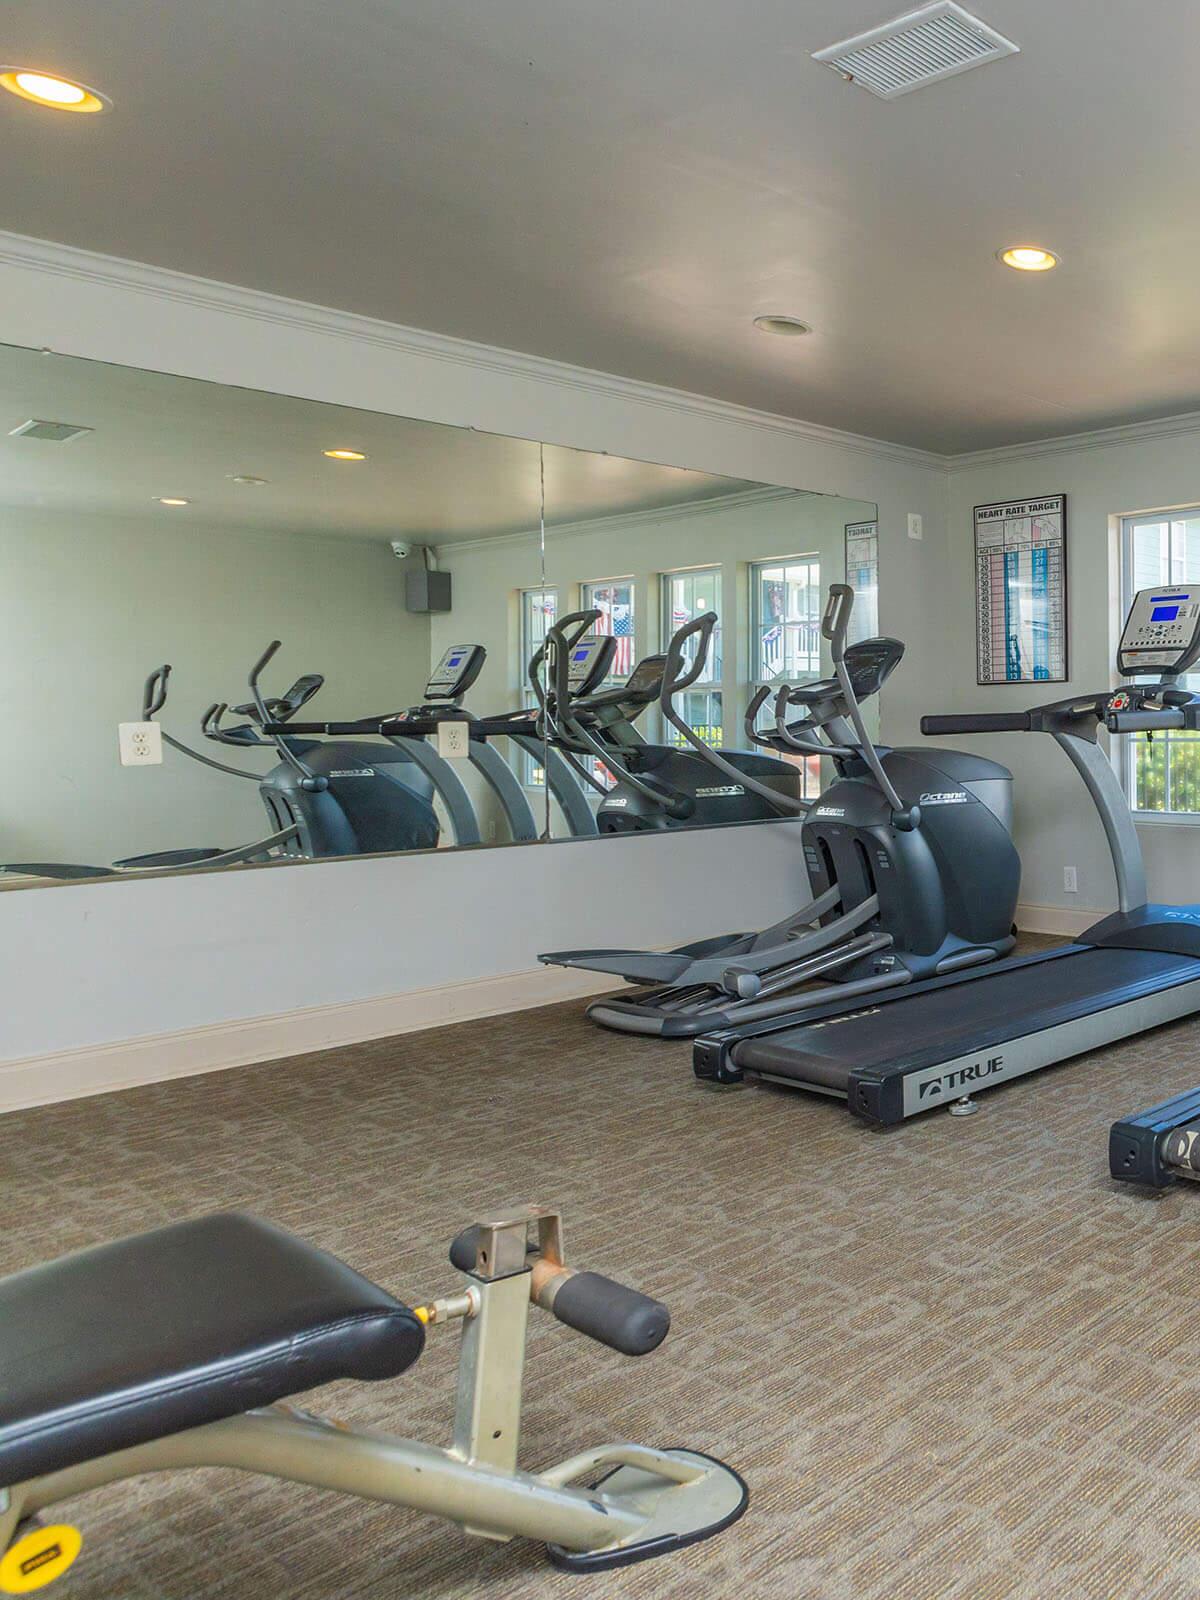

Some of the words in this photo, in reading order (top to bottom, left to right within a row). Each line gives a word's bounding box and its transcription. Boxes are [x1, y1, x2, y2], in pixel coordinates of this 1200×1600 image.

[978, 509, 1003, 519] HEART
[1005, 506, 1026, 515] RATE
[1028, 501, 1060, 513] TARGET
[919, 792, 966, 801] Octane
[944, 1056, 1004, 1089] TRUE
